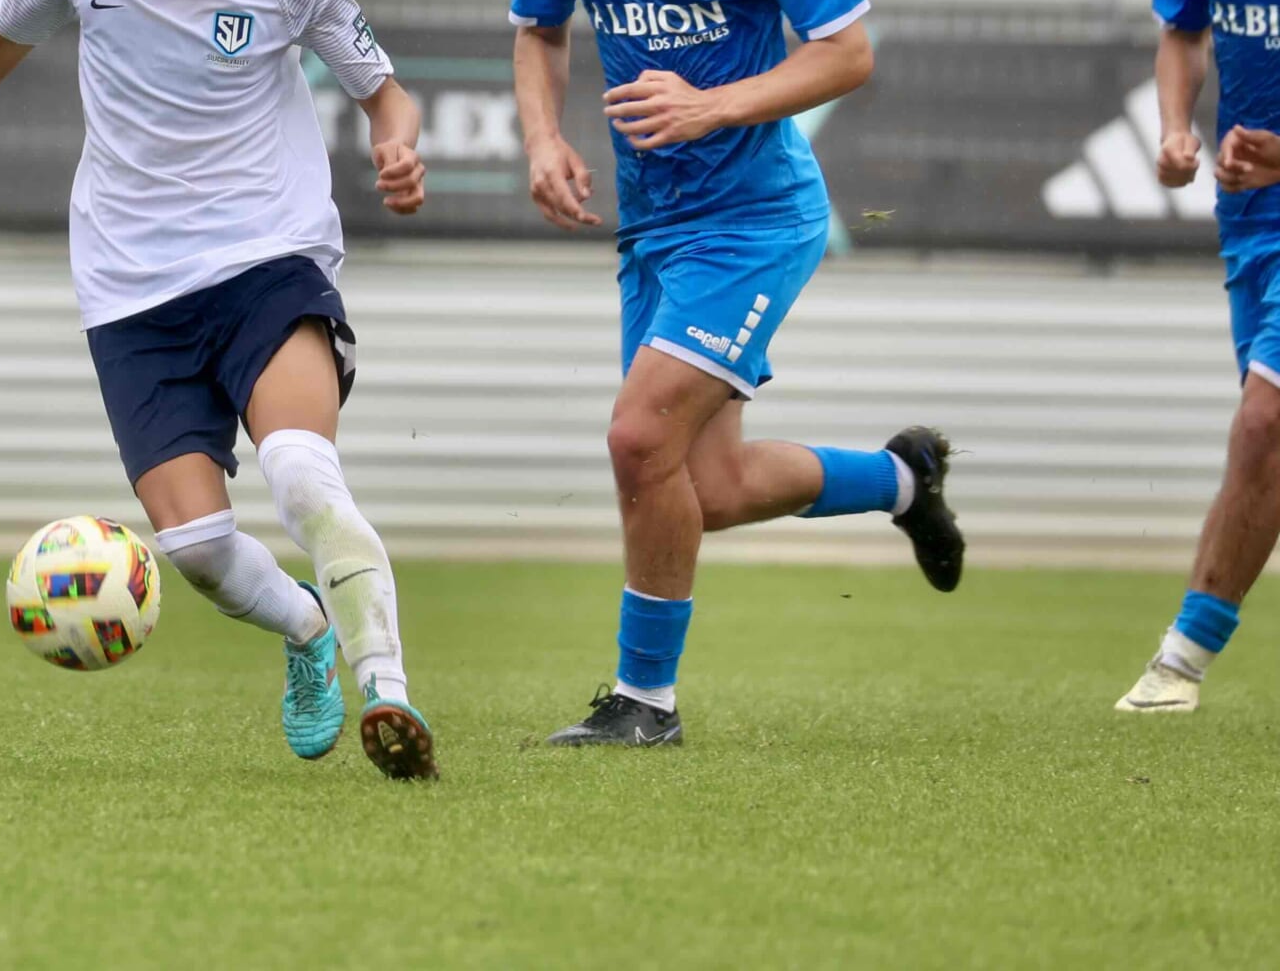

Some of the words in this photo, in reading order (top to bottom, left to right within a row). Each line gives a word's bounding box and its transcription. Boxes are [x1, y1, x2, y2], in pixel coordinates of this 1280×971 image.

[592, 1, 727, 37] ALBION
[648, 35, 671, 52] LOS
[673, 25, 730, 49] ANGELES
[686, 326, 731, 353] capelli
